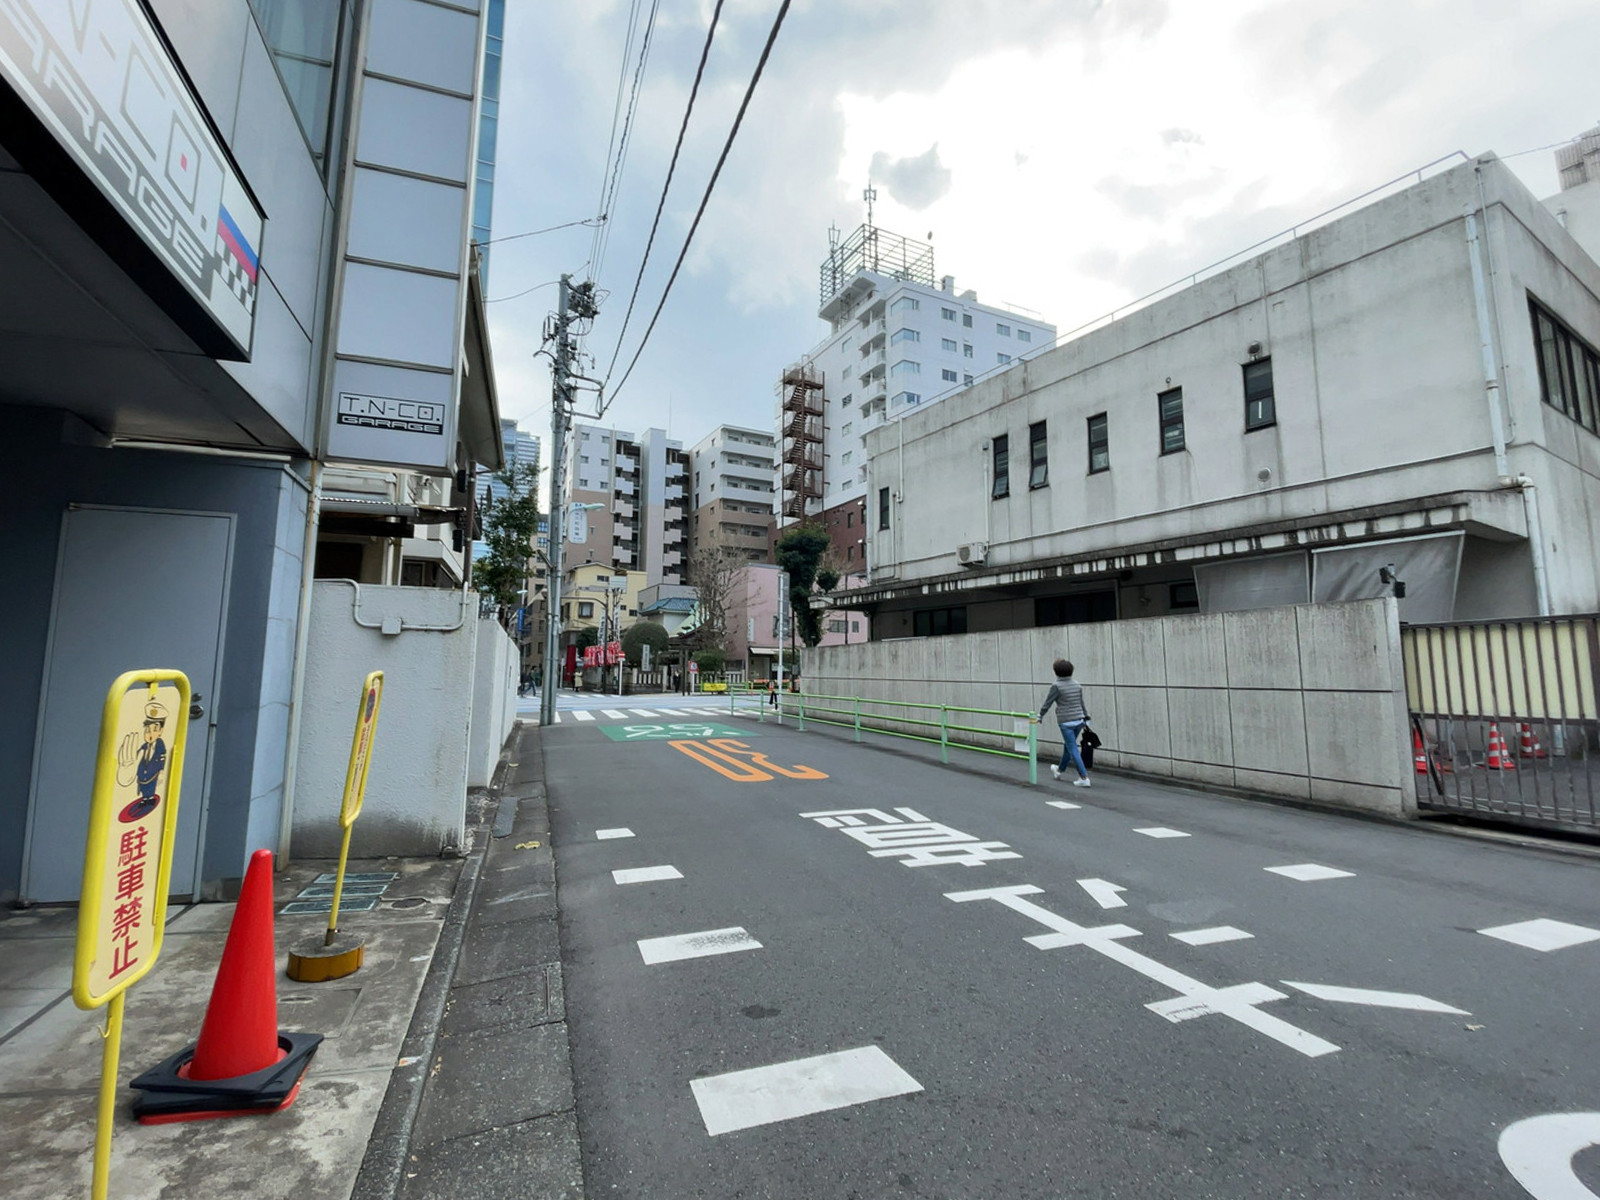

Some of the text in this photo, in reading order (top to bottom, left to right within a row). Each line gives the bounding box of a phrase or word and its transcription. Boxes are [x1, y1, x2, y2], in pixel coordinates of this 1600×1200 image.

[341, 416, 440, 433] GARAGE
[668, 739, 830, 782] 30
[109, 826, 148, 980] 駐車禁止
[799, 807, 1472, 1058] 注意
